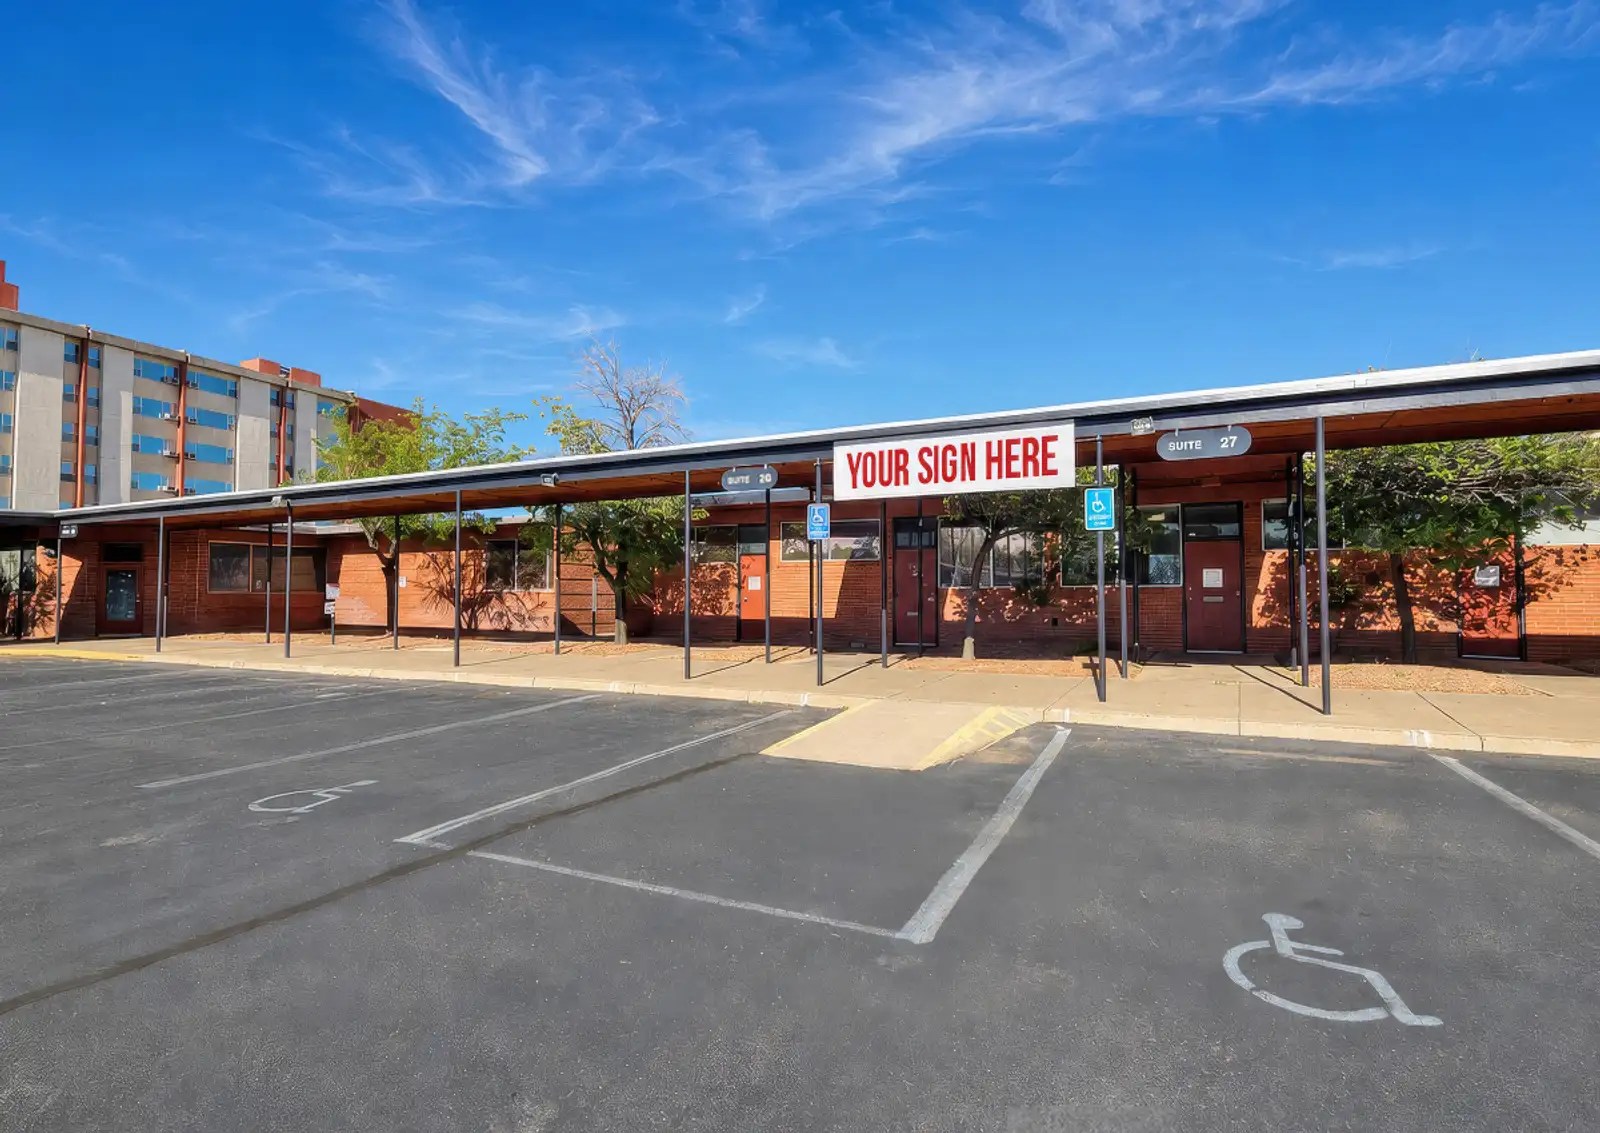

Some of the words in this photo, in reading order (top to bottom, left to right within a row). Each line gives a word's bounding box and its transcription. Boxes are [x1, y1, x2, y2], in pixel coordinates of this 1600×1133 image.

[1168, 439, 1202, 451] SUITE
[1220, 435, 1238, 448] 27
[847, 448, 909, 489] YOUR
[917, 441, 976, 484] SIGN
[985, 435, 1059, 480] HERE
